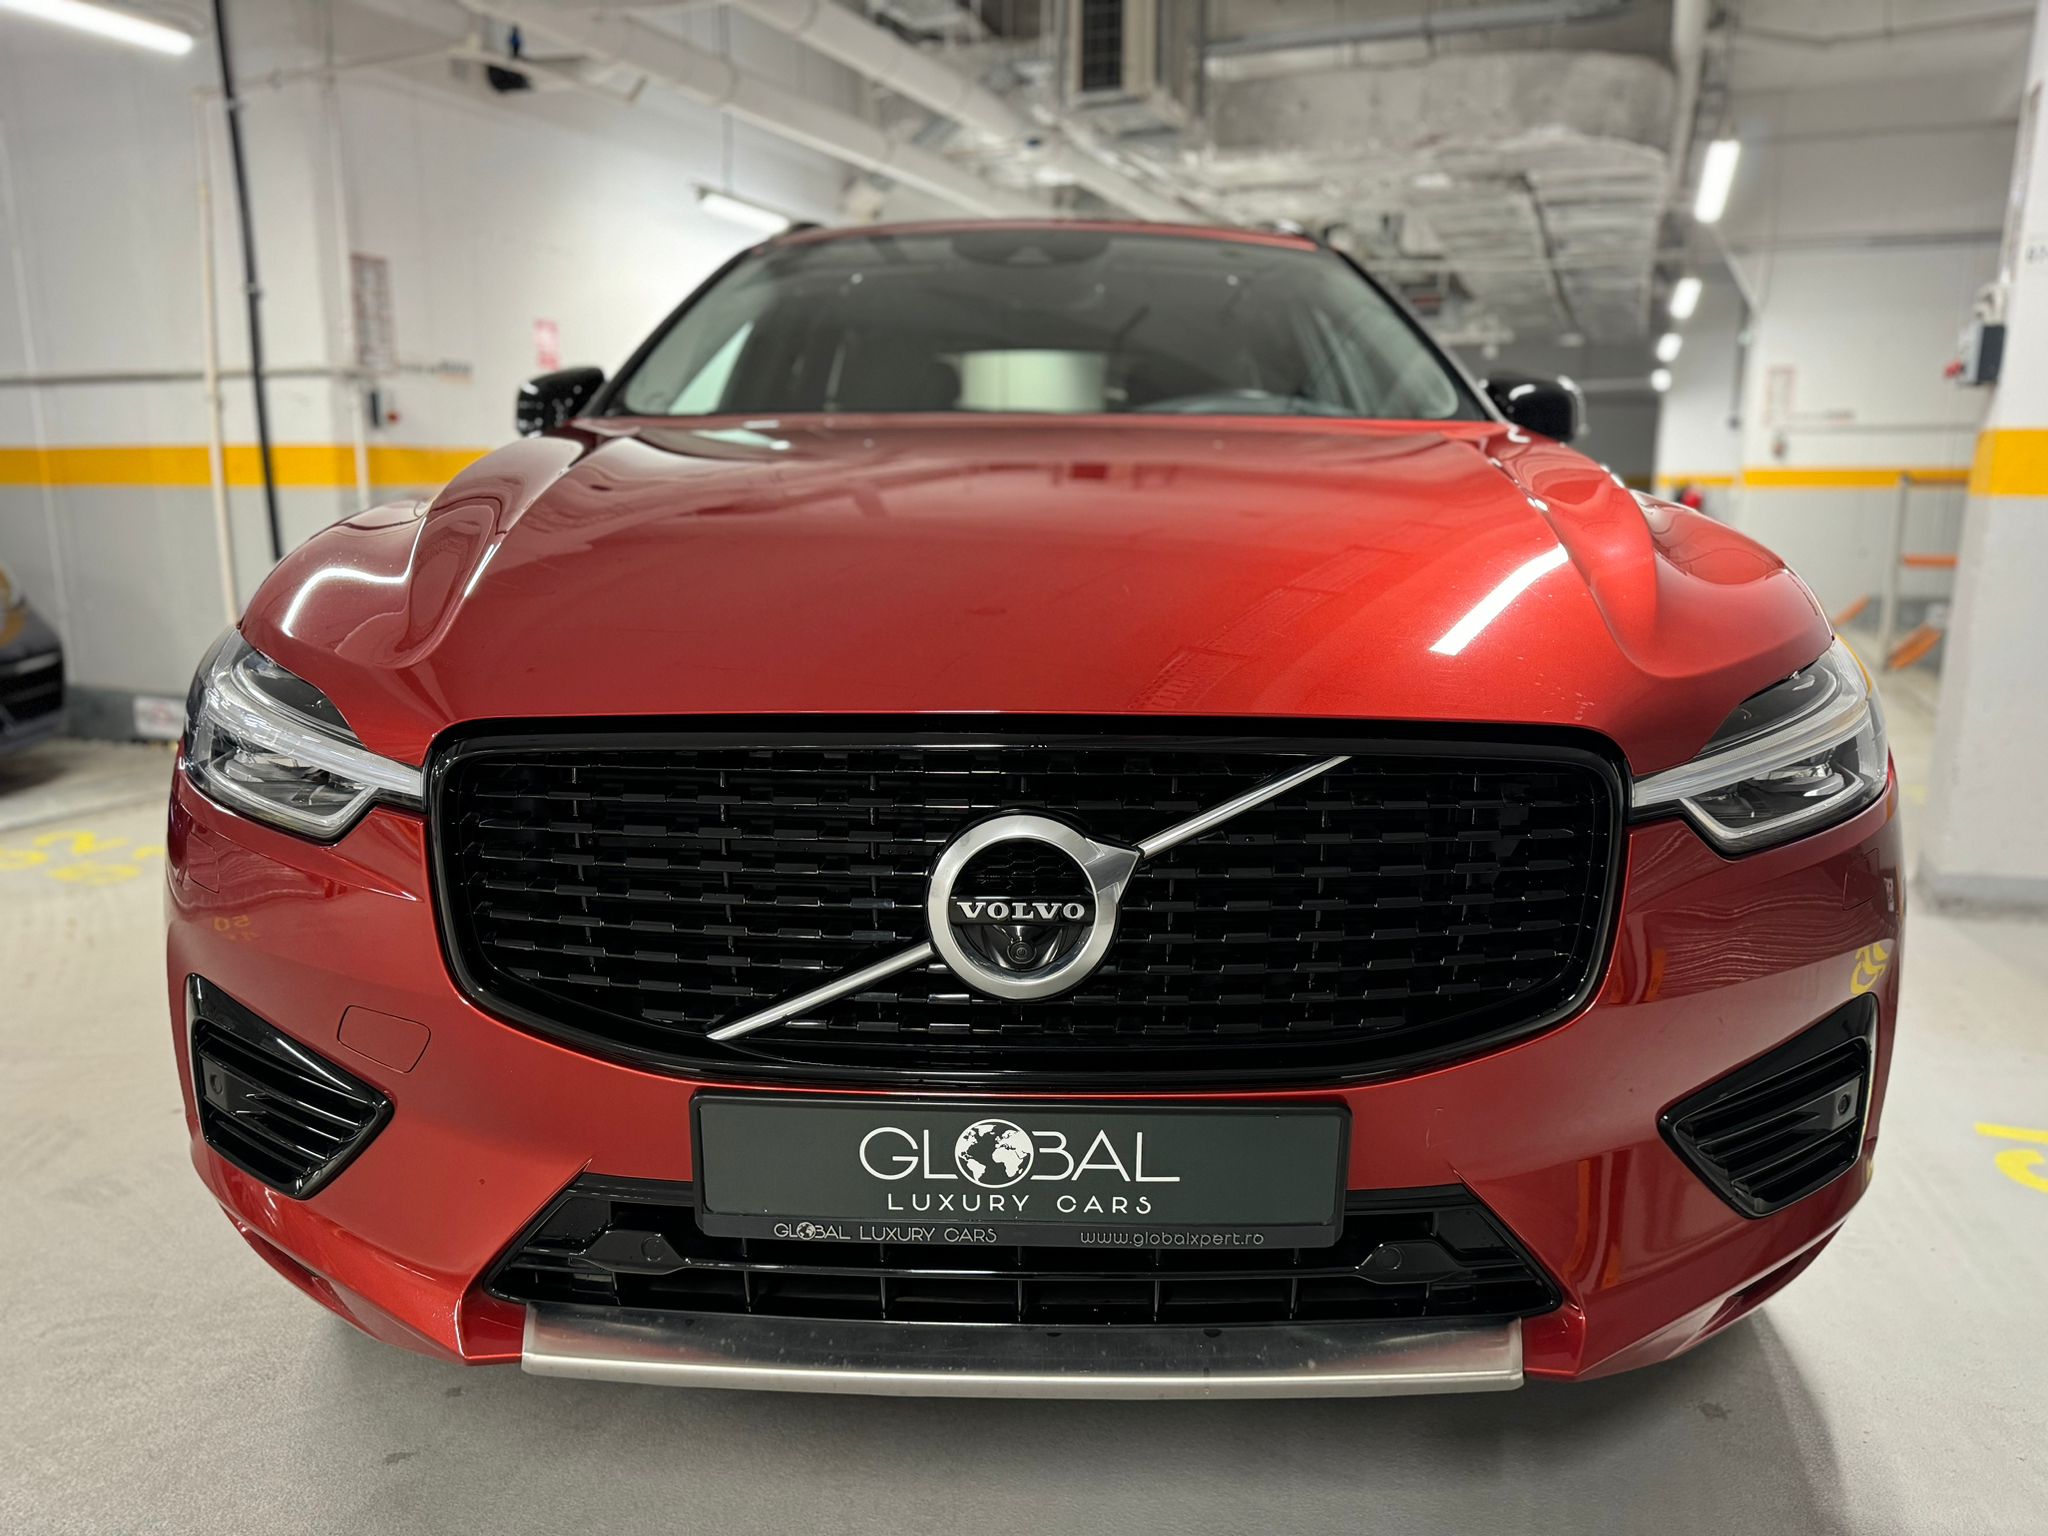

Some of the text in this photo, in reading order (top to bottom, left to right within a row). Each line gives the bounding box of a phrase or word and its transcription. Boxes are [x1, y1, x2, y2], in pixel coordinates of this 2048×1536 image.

[956, 902, 1085, 919] VOLVO
[859, 1118, 1180, 1189] GLOBAL
[887, 1193, 1152, 1214] LUXURY CARS
[773, 1221, 998, 1243] GLOBAL LUXURY CARS
[1080, 1231, 1265, 1248] www.globalxpert.ro
